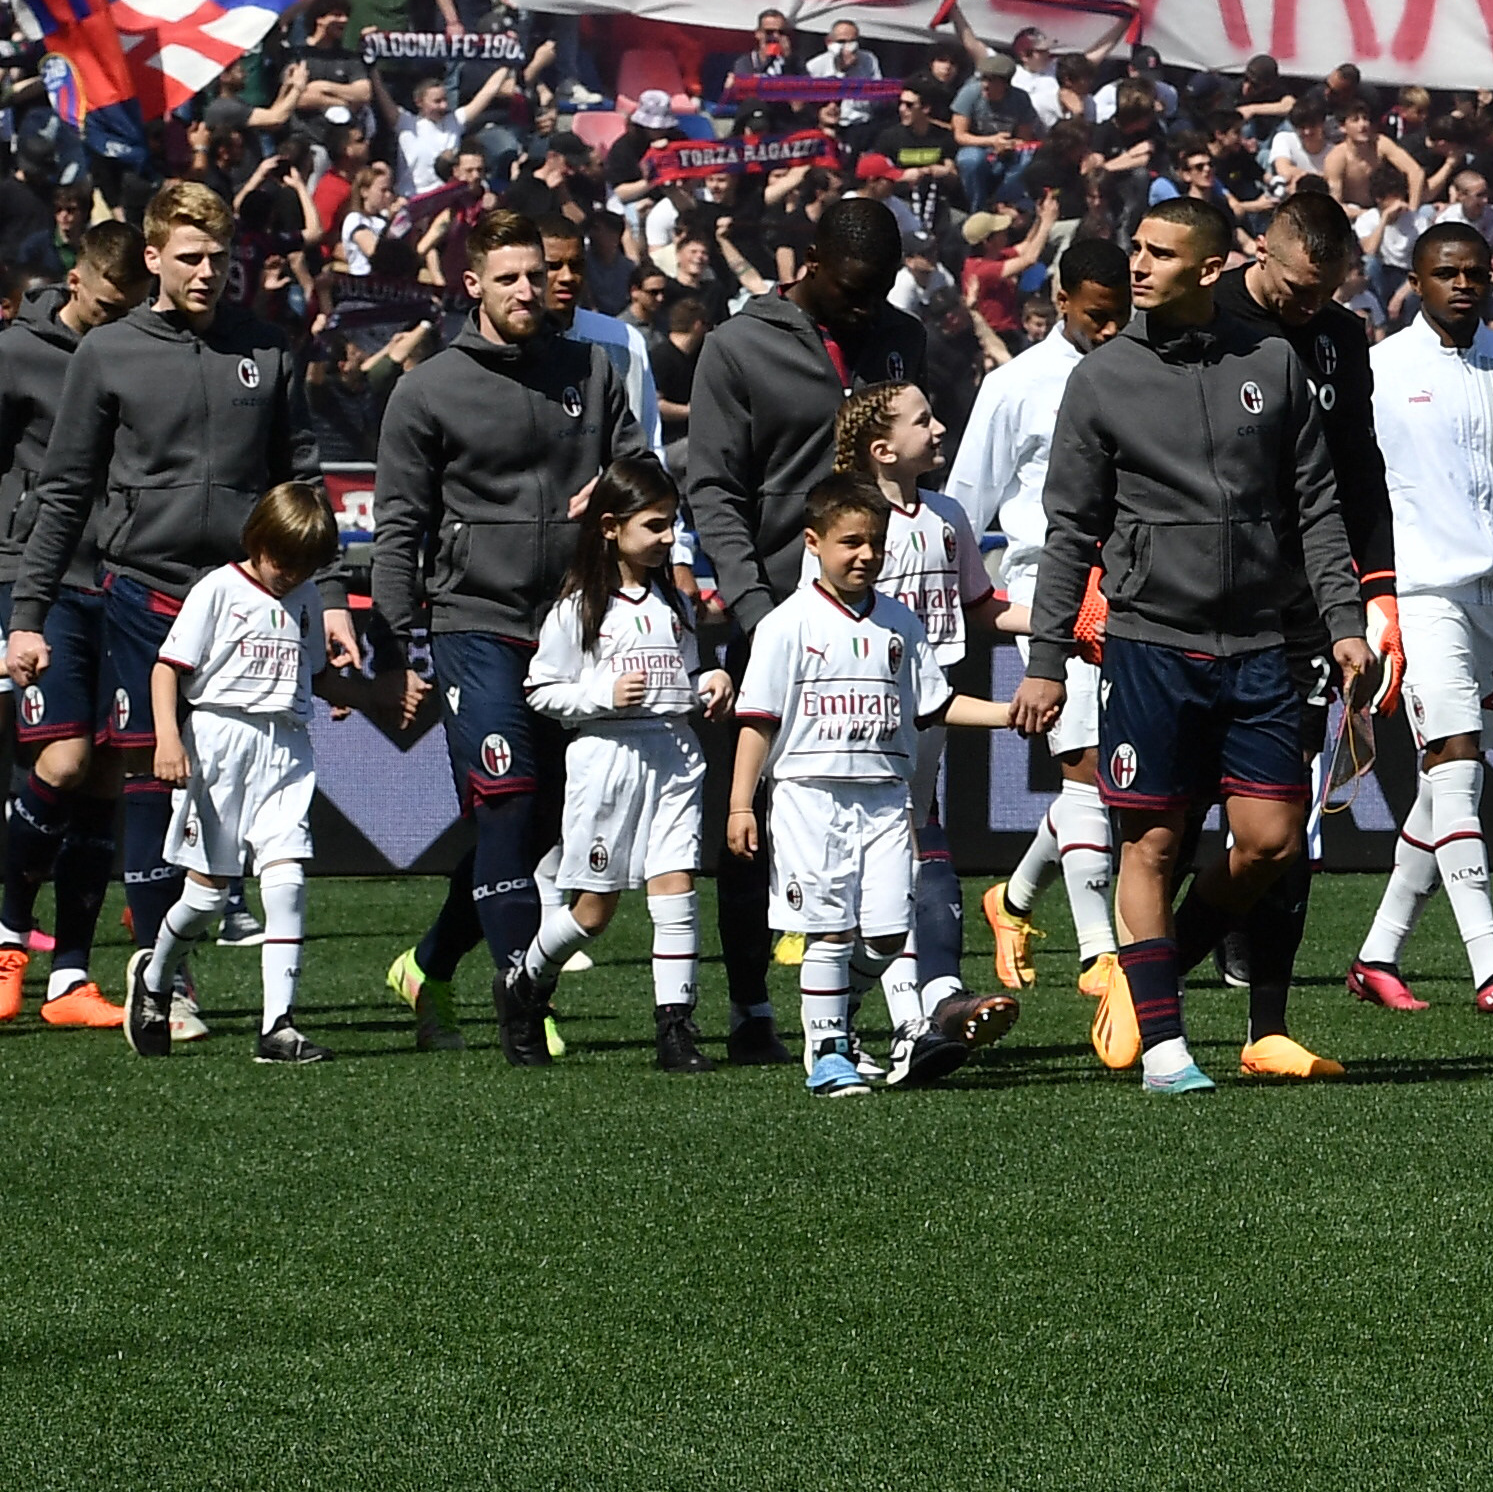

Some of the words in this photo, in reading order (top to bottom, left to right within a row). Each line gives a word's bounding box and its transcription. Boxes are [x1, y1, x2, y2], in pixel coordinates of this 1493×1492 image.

[449, 34, 479, 62] FC
[678, 144, 738, 168] FORZA
[895, 587, 959, 611] mirate
[611, 650, 685, 676] Emirates
[818, 718, 845, 740] FLY
[1449, 866, 1485, 884] ACM
[810, 1017, 842, 1031] ACM
